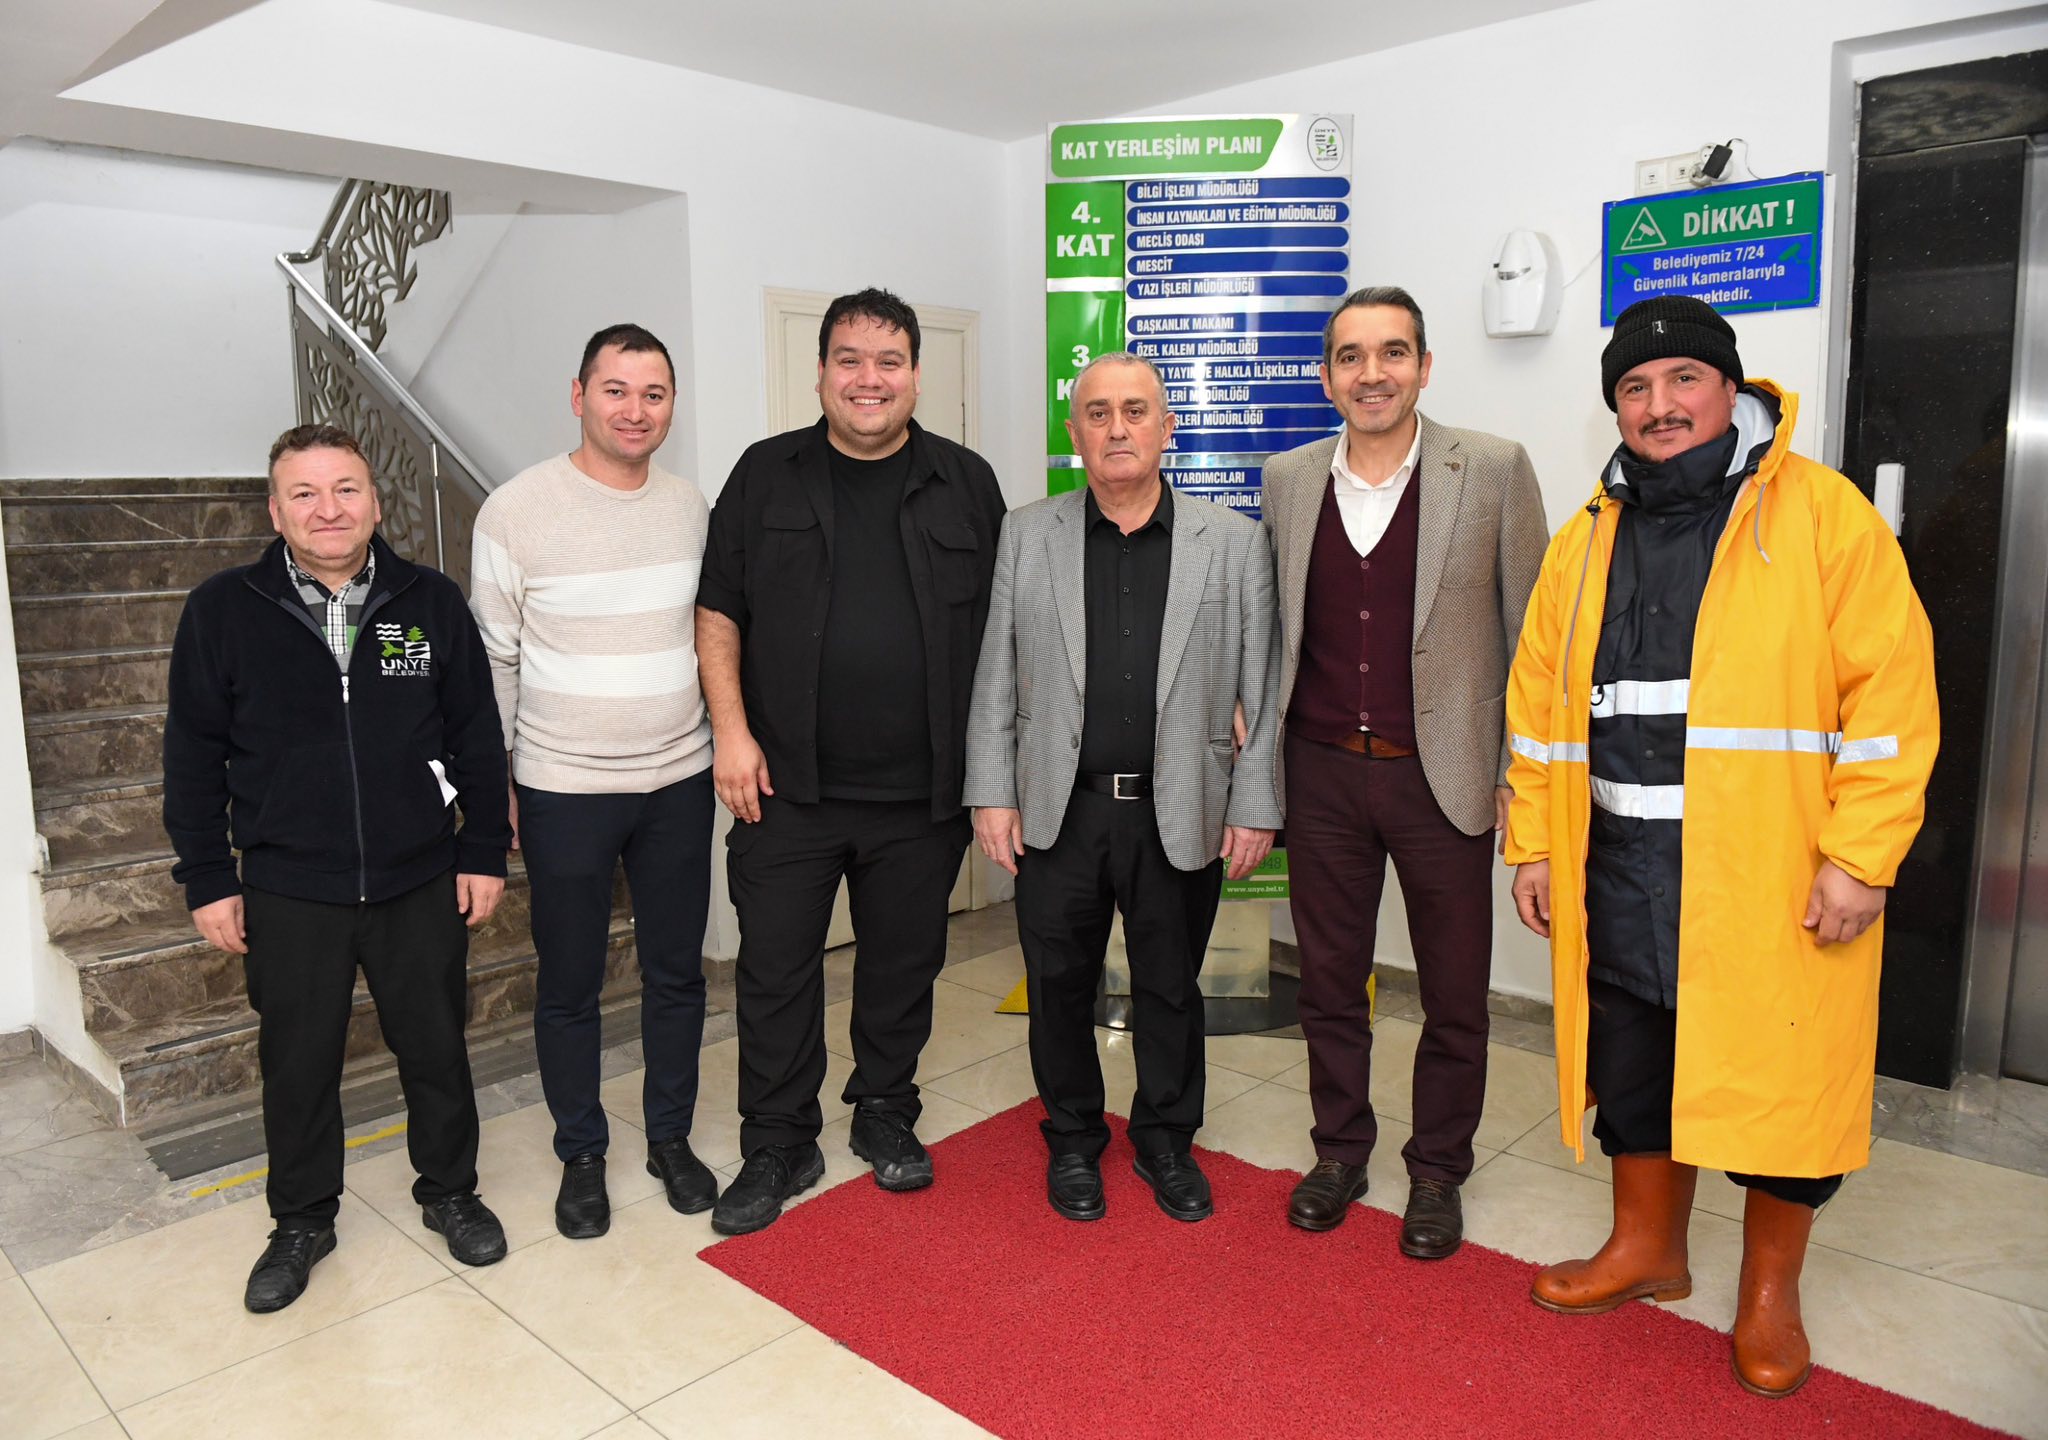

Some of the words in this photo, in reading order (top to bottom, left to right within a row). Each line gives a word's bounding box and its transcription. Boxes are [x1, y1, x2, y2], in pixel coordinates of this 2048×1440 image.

[1061, 141, 1099, 160] KAT
[1104, 133, 1200, 160] YERLEŞİM
[1206, 136, 1262, 154] PLANI
[1137, 182, 1162, 199] BİLGİ
[1165, 182, 1195, 200] İŞLEM
[1197, 179, 1259, 197] MÜDÜRLÜĞÜ
[1071, 201, 1101, 224] 4.
[1137, 210, 1164, 225] İNSAN
[1167, 209, 1226, 224] KAYNAKLARI
[1228, 208, 1241, 222] VE
[1243, 204, 1277, 221] EĞİTİM
[1279, 204, 1337, 221] MÜDÜRLÜĞÜ
[1683, 201, 1779, 238] DİKKAT
[1786, 199, 1795, 225] !
[1057, 234, 1115, 257] KAT
[1136, 231, 1173, 248] MECLİS
[1175, 233, 1205, 246] ODASI
[1136, 255, 1173, 273] MESCİT
[1653, 249, 1732, 271] Belediyemiz
[1735, 245, 1765, 262] 7/24
[1137, 283, 1159, 296] YAZI
[1161, 279, 1192, 297] İŞLERİ
[1194, 277, 1255, 294] MÜDÜRLÜĞÜ
[1633, 273, 1688, 293] Güvenlik
[1691, 263, 1786, 287] Kameralarıyla
[1136, 318, 1190, 334] BAŞKANLIK
[1192, 317, 1234, 331] MAKAMI
[1137, 341, 1159, 357] ÖZEL
[1161, 343, 1195, 356] KALEM
[1198, 339, 1259, 355] MÜDÜRLÜĞÜ
[1214, 365, 1252, 378] HALKLA
[1254, 361, 1299, 380] İLİŞKİLER
[1174, 411, 1200, 428] ŞLERİ
[1203, 410, 1264, 426] MÜDÜRLÜĞÜ
[1176, 471, 1245, 485] YARDIMCILARI
[1213, 492, 1260, 507] MÜDÜRLÜ
